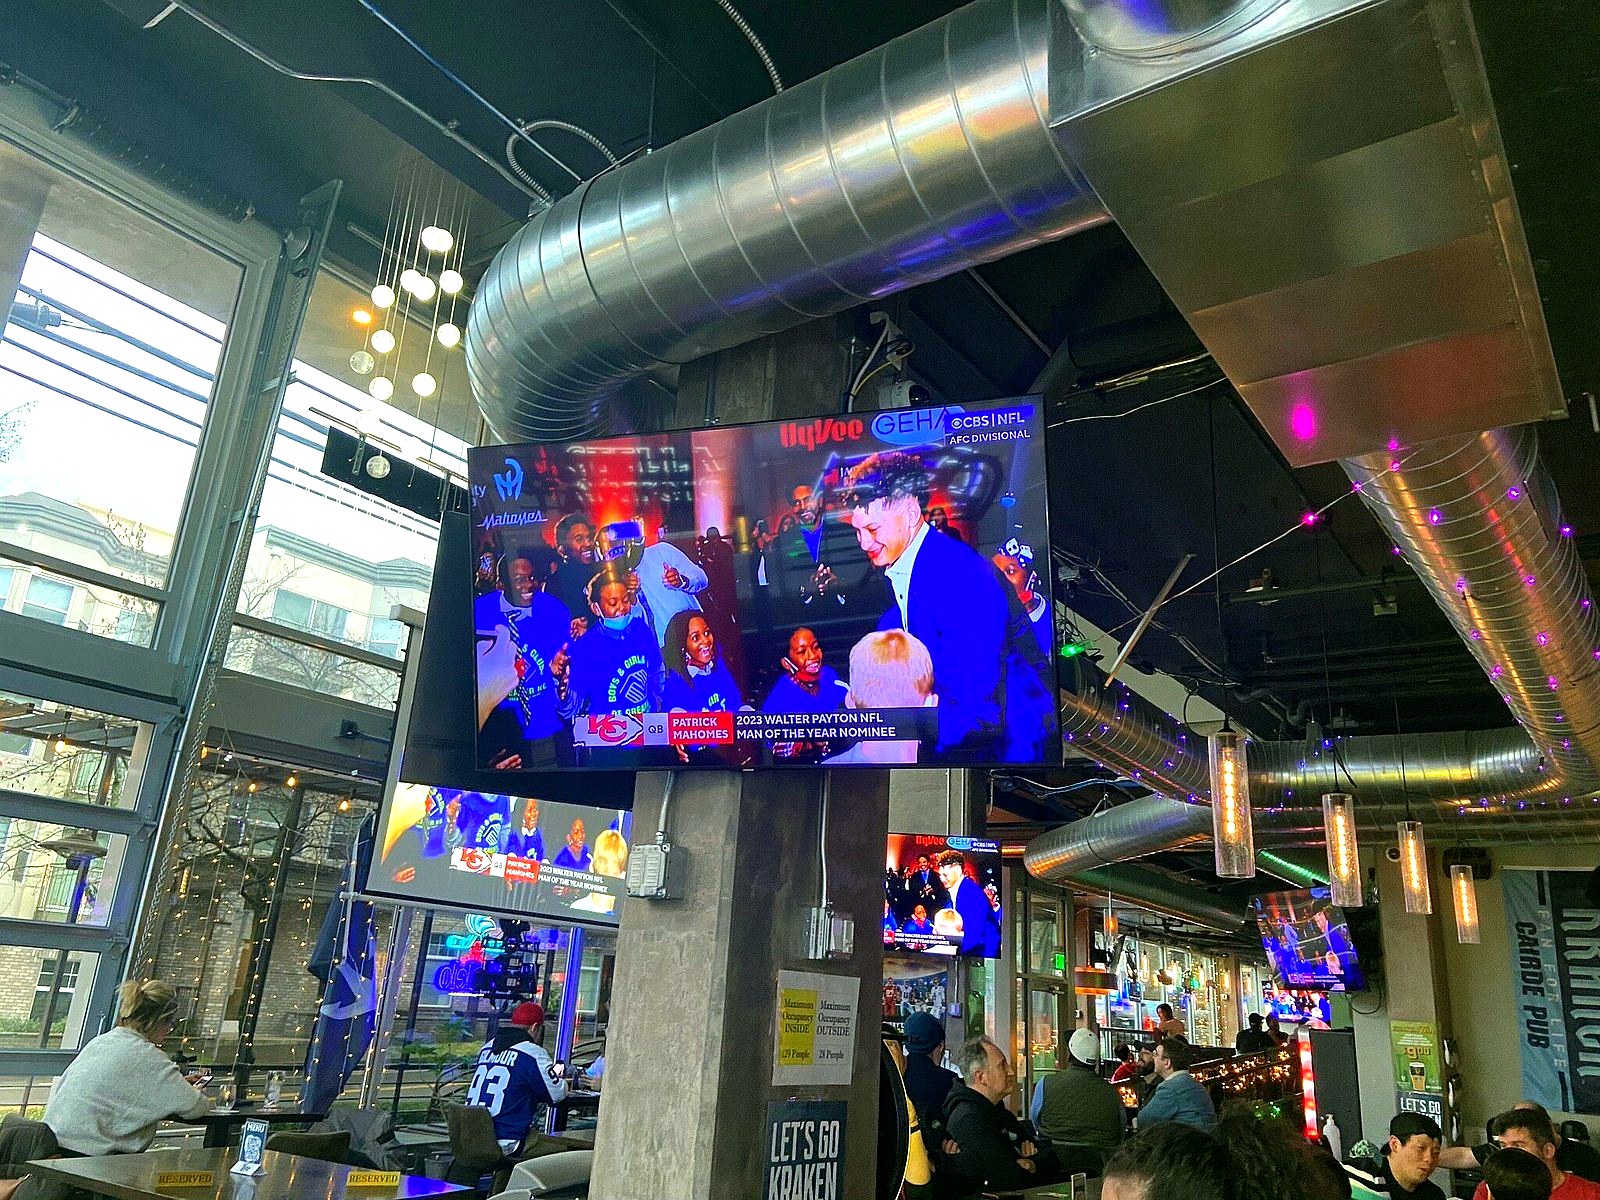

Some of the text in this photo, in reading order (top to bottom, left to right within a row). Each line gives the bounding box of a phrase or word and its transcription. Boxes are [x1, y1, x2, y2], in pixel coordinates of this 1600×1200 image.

[964, 411, 1025, 429] CBS NFL
[780, 418, 863, 451] HyVee
[949, 429, 1031, 445] AFC DIVISIONAL
[672, 717, 718, 728] PATRICK
[736, 712, 883, 726] 2023 WALTER PAYTON NFL
[648, 725, 664, 735] QB
[673, 729, 729, 740] MAHOMES
[737, 726, 896, 739] MAN OF THE YEAR NOMINEE
[1514, 921, 1550, 1049] CAIRDE PUB
[1537, 909, 1568, 1068] FAN FOR LIFE
[784, 998, 814, 1010] Maximum
[820, 1000, 851, 1011] Maximum
[782, 1011, 814, 1024] Occupancy
[818, 1013, 851, 1026] Occupancy
[784, 1023, 810, 1034] INSIDE
[817, 1025, 850, 1037] OUTSIDE
[791, 1049, 810, 1061] People
[826, 1050, 845, 1061] People
[1400, 1097, 1441, 1114] LET'S GO
[770, 1120, 840, 1163] LET'S GO
[157, 1174, 213, 1185] RESERVED
[348, 1174, 399, 1183] RESERVED
[768, 1161, 838, 1200] KRAKEN
